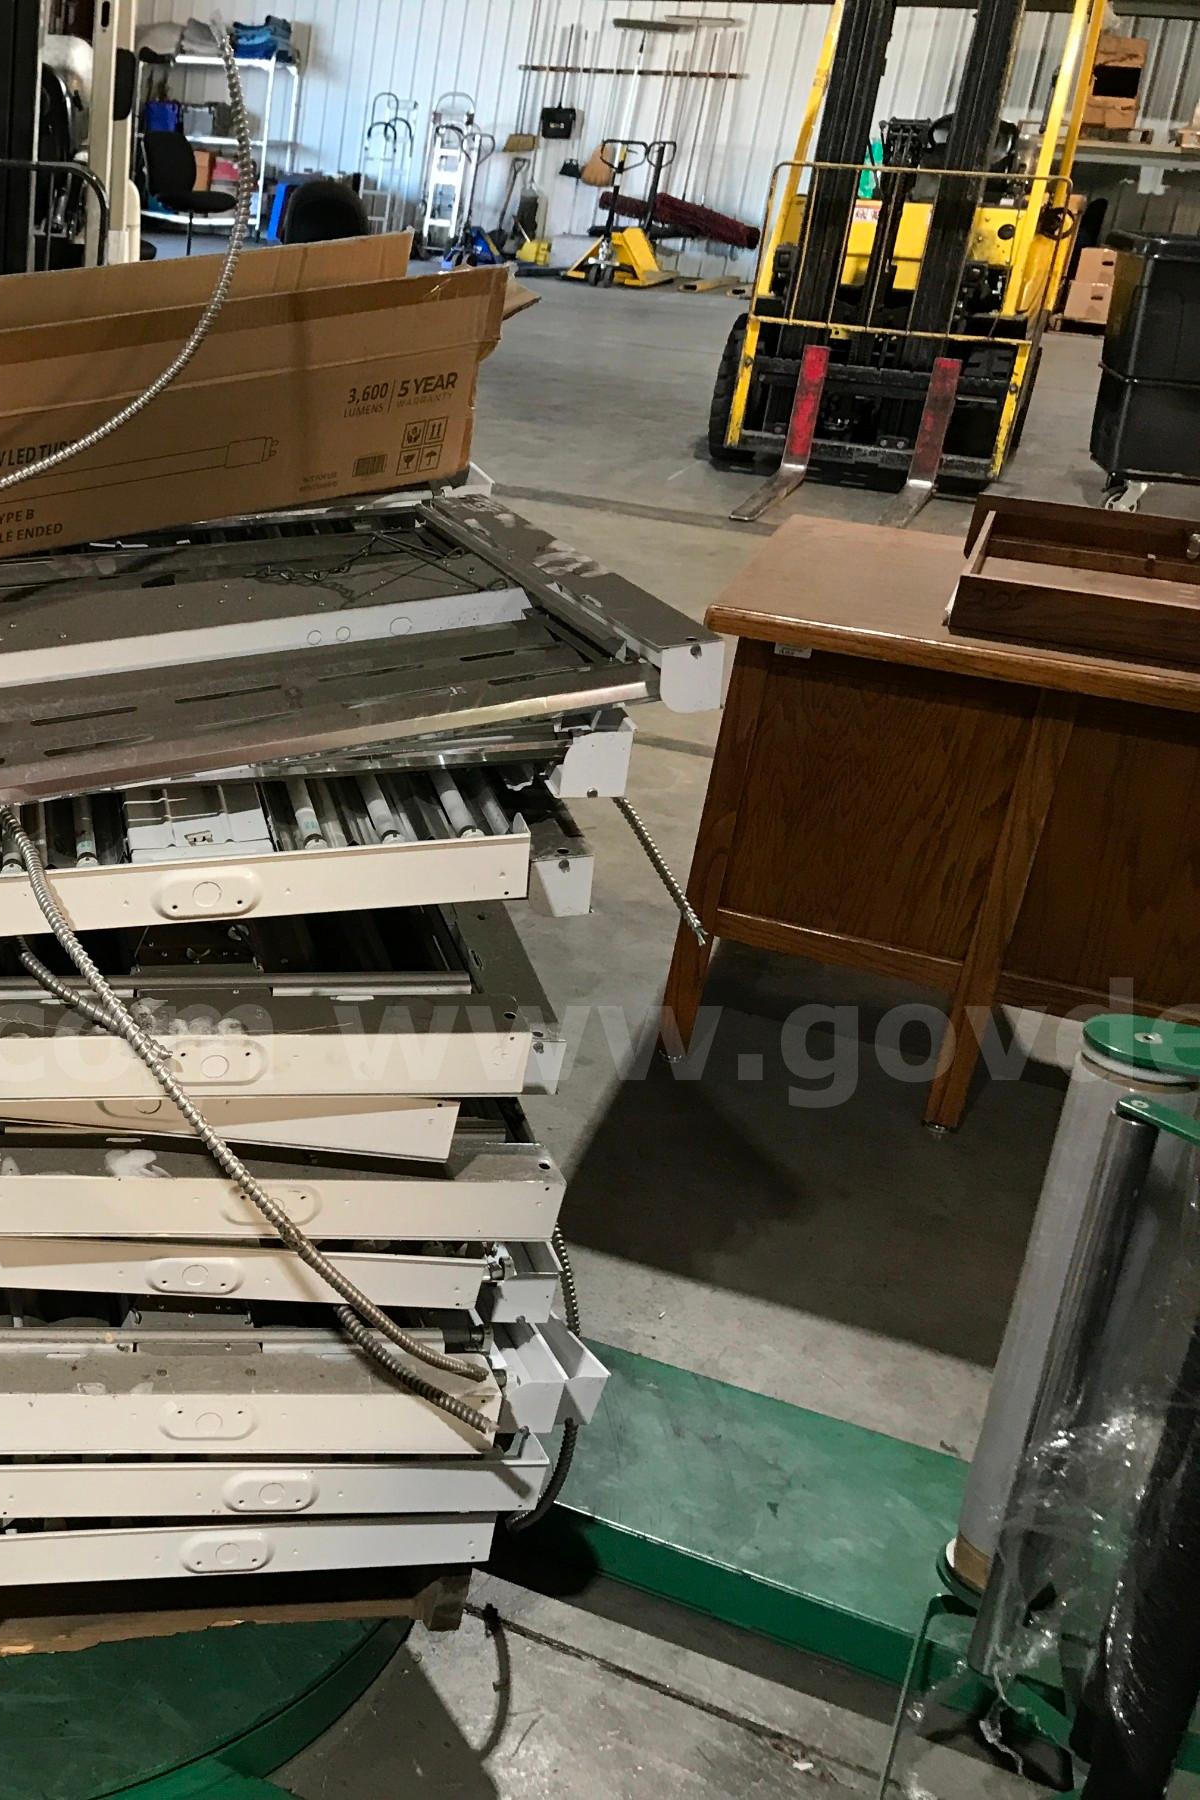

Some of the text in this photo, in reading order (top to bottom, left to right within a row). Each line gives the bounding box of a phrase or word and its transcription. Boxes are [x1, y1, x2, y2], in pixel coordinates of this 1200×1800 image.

[347, 382, 389, 405] 3,600
[397, 372, 458, 397] 5 YEAR
[343, 404, 384, 418] LUMENS
[7, 447, 36, 467] LED
[26, 509, 35, 520] B
[16, 523, 63, 541] ENDED
